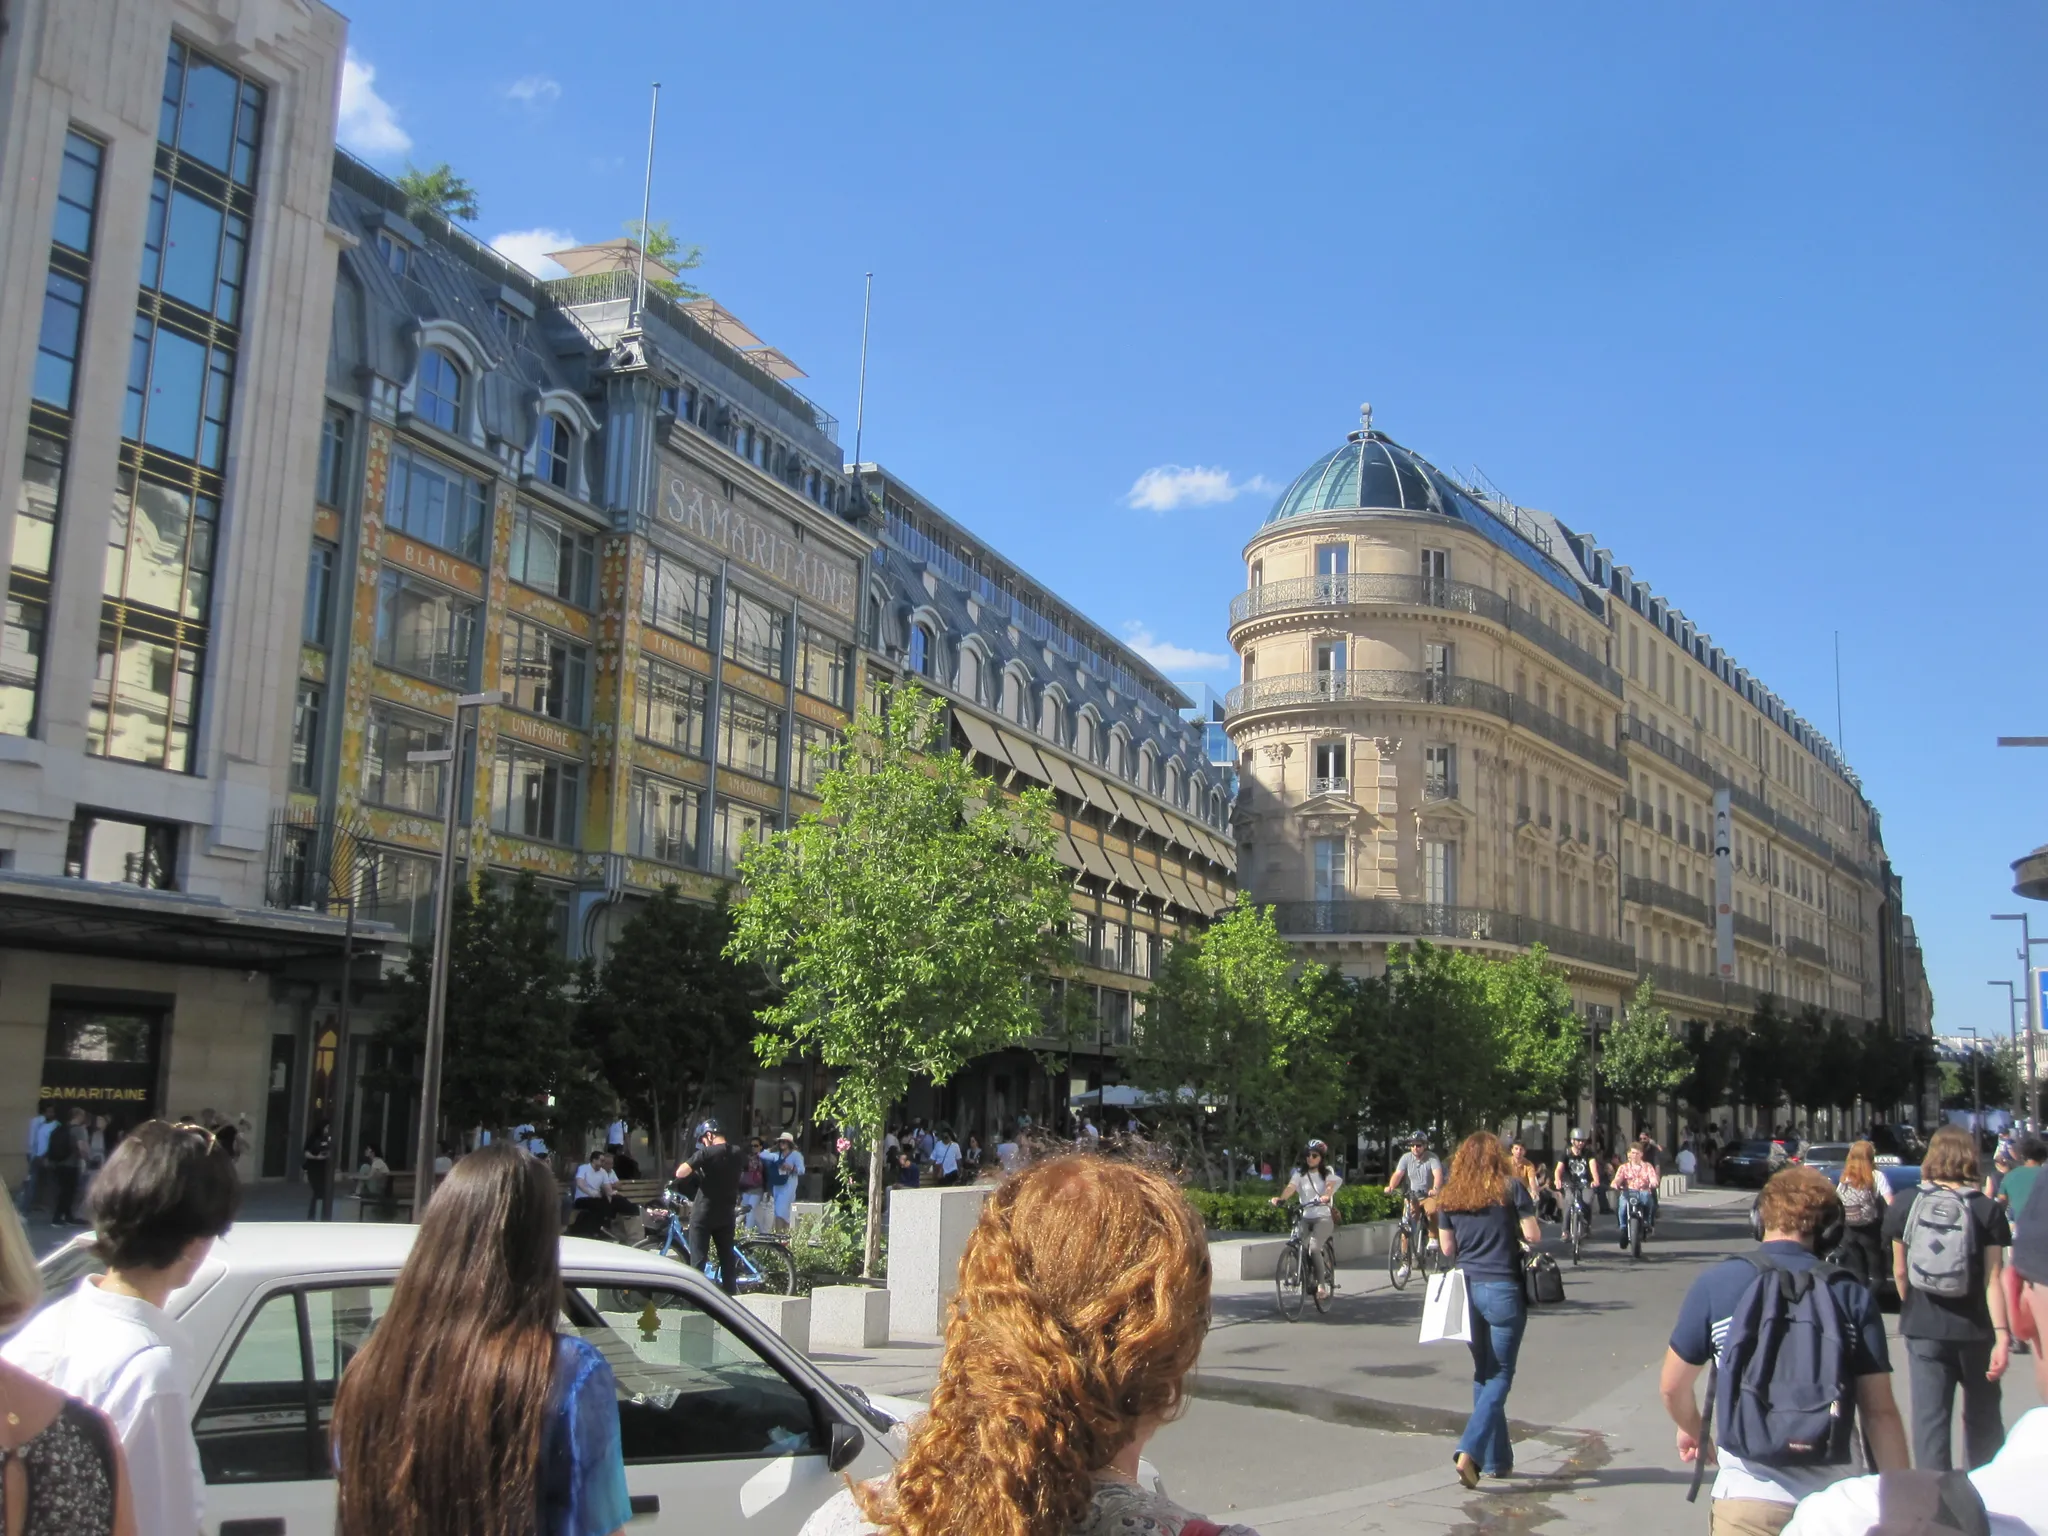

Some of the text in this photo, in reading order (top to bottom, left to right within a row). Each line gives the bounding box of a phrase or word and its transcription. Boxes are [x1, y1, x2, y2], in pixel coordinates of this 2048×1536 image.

[668, 479, 852, 614] SAMARITAINE
[405, 544, 460, 581] BLANC
[654, 634, 698, 666] TRAVAIL
[512, 717, 569, 748] UNIFORME
[728, 776, 769, 801] AMAZONE
[40, 1086, 147, 1101] SAMARITAINE
